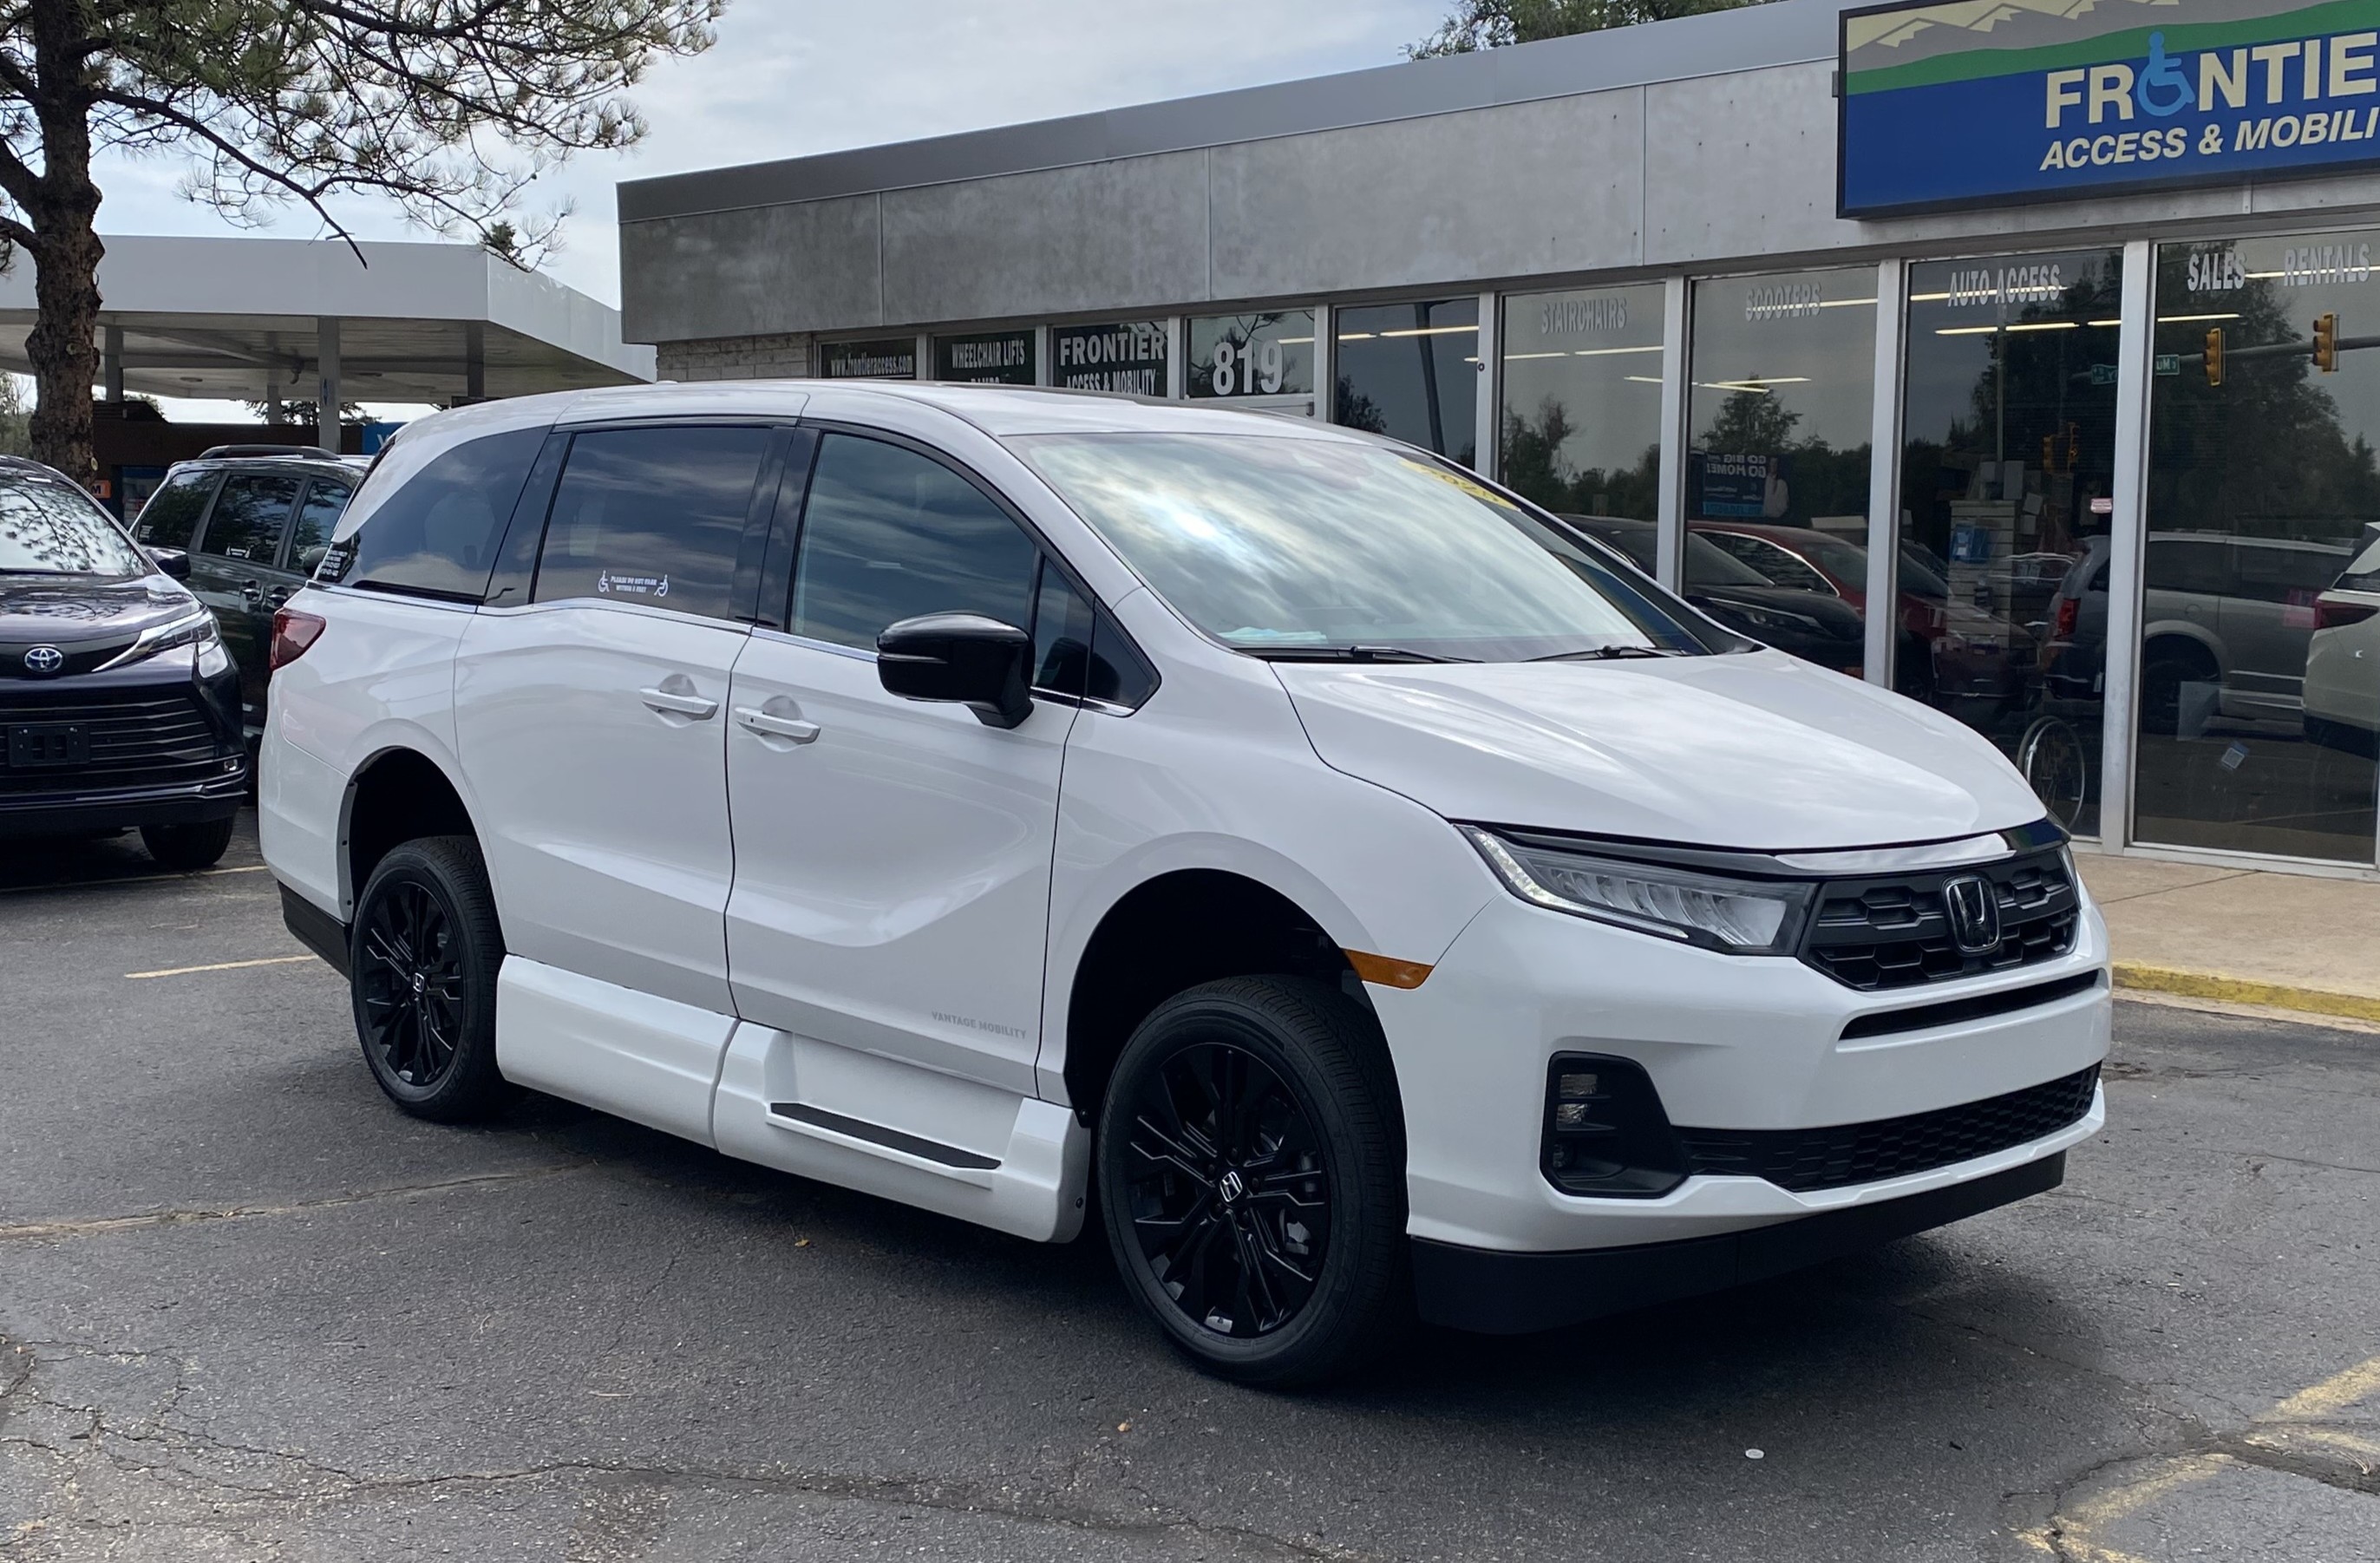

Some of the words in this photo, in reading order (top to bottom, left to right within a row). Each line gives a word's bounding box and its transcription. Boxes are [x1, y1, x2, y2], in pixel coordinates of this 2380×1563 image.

[2039, 127, 2187, 171] ACCESS
[2198, 124, 2224, 155] &
[2233, 106, 2380, 152] MOBILI
[2187, 251, 2247, 292] SALES
[2283, 243, 2371, 287] RENTALS
[1745, 282, 1821, 323] SCOOTERS
[1947, 269, 1991, 308] AUTO
[1995, 264, 2061, 304] ACCESS
[1541, 297, 1628, 335] STAIRCHAIRS
[830, 351, 913, 377] www.frontieraccess.com
[951, 341, 1003, 369] WHEELCHAIR
[1004, 339, 1025, 366] LIFTS
[1059, 330, 1165, 367] FRONTIER
[1213, 338, 1284, 396] 819
[1112, 368, 1157, 396] MOBILITY
[931, 1010, 977, 1030] VANTAGE
[978, 1019, 1027, 1040] MOBILITY
